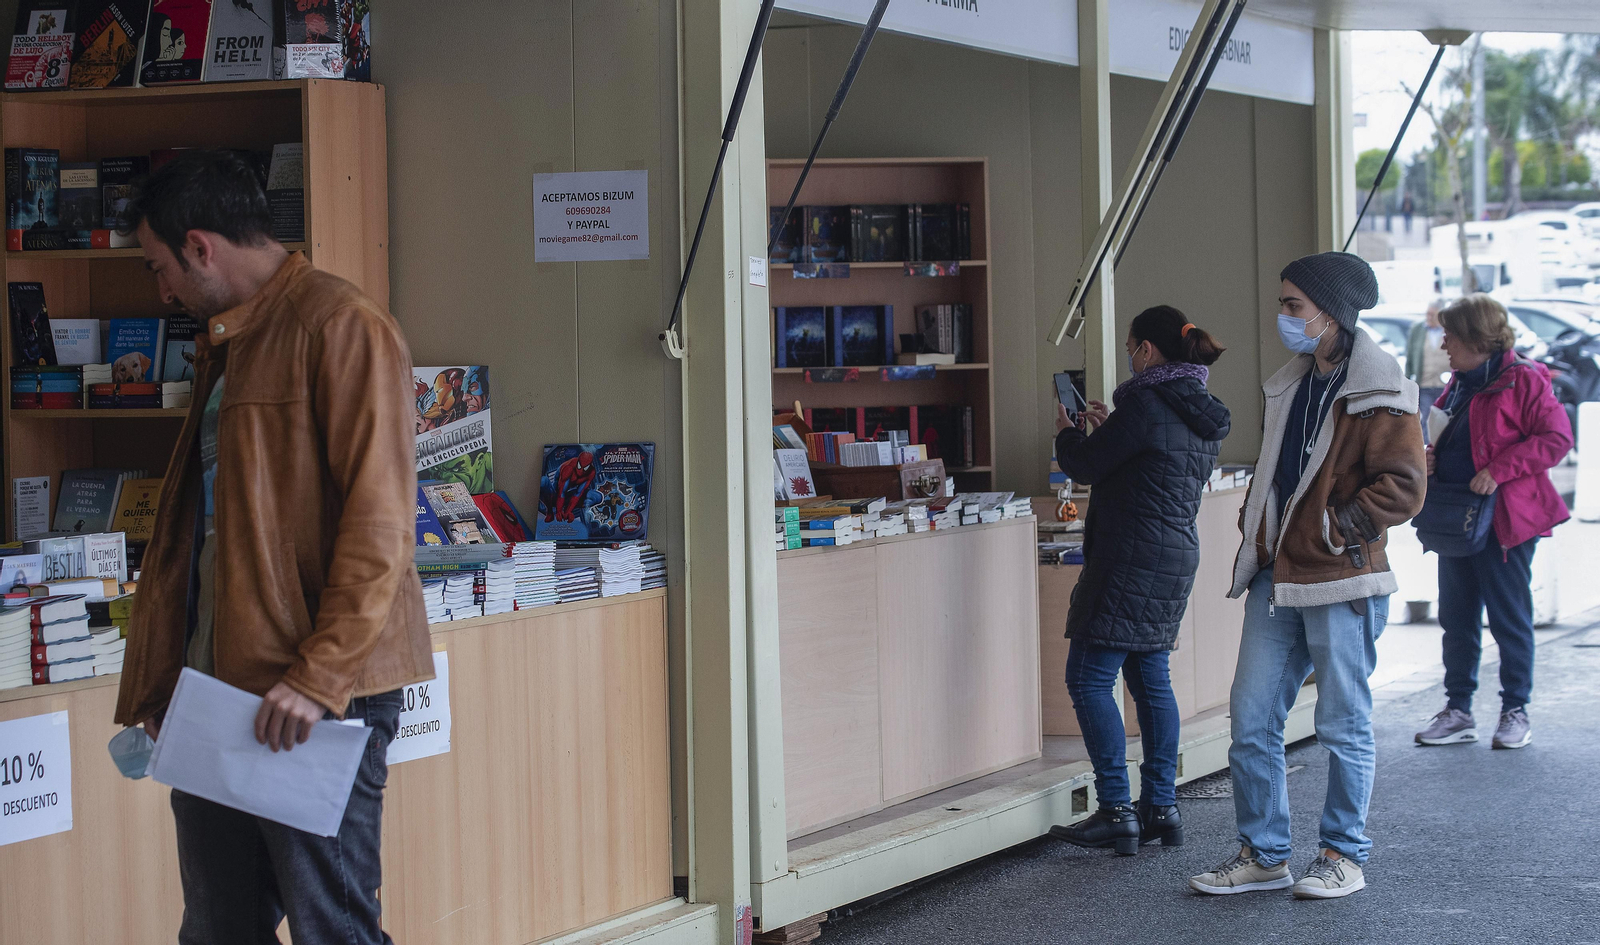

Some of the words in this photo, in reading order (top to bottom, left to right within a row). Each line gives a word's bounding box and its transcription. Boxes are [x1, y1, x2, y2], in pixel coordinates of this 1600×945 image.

[80, 8, 114, 48] BERLIN
[109, 3, 122, 21] JASON
[120, 18, 136, 38] LUTES
[216, 35, 264, 50] FROM
[1169, 26, 1192, 51] EDIC
[214, 49, 262, 63] HELL
[1219, 37, 1252, 65] ABNAR
[542, 192, 600, 202] ACEPTAMOS
[602, 191, 634, 201] BIZUM
[565, 206, 611, 215] 609690284
[567, 221, 574, 229] Y
[576, 220, 610, 229] PAYPAL
[539, 233, 639, 244] moviegame82@gmail.com
[421, 459, 434, 467] LA
[433, 438, 488, 463] ENCICLOPEDIA
[76, 490, 97, 498] ATRÁS
[91, 548, 117, 561] ÚLTIMOS
[45, 552, 84, 581] BESTIA
[99, 560, 112, 573] DÍAS
[418, 684, 430, 709] %
[401, 720, 440, 739] DESCUENTO
[1, 755, 23, 786] 10
[28, 750, 44, 781] %
[3, 792, 58, 816] DESCUENTO
